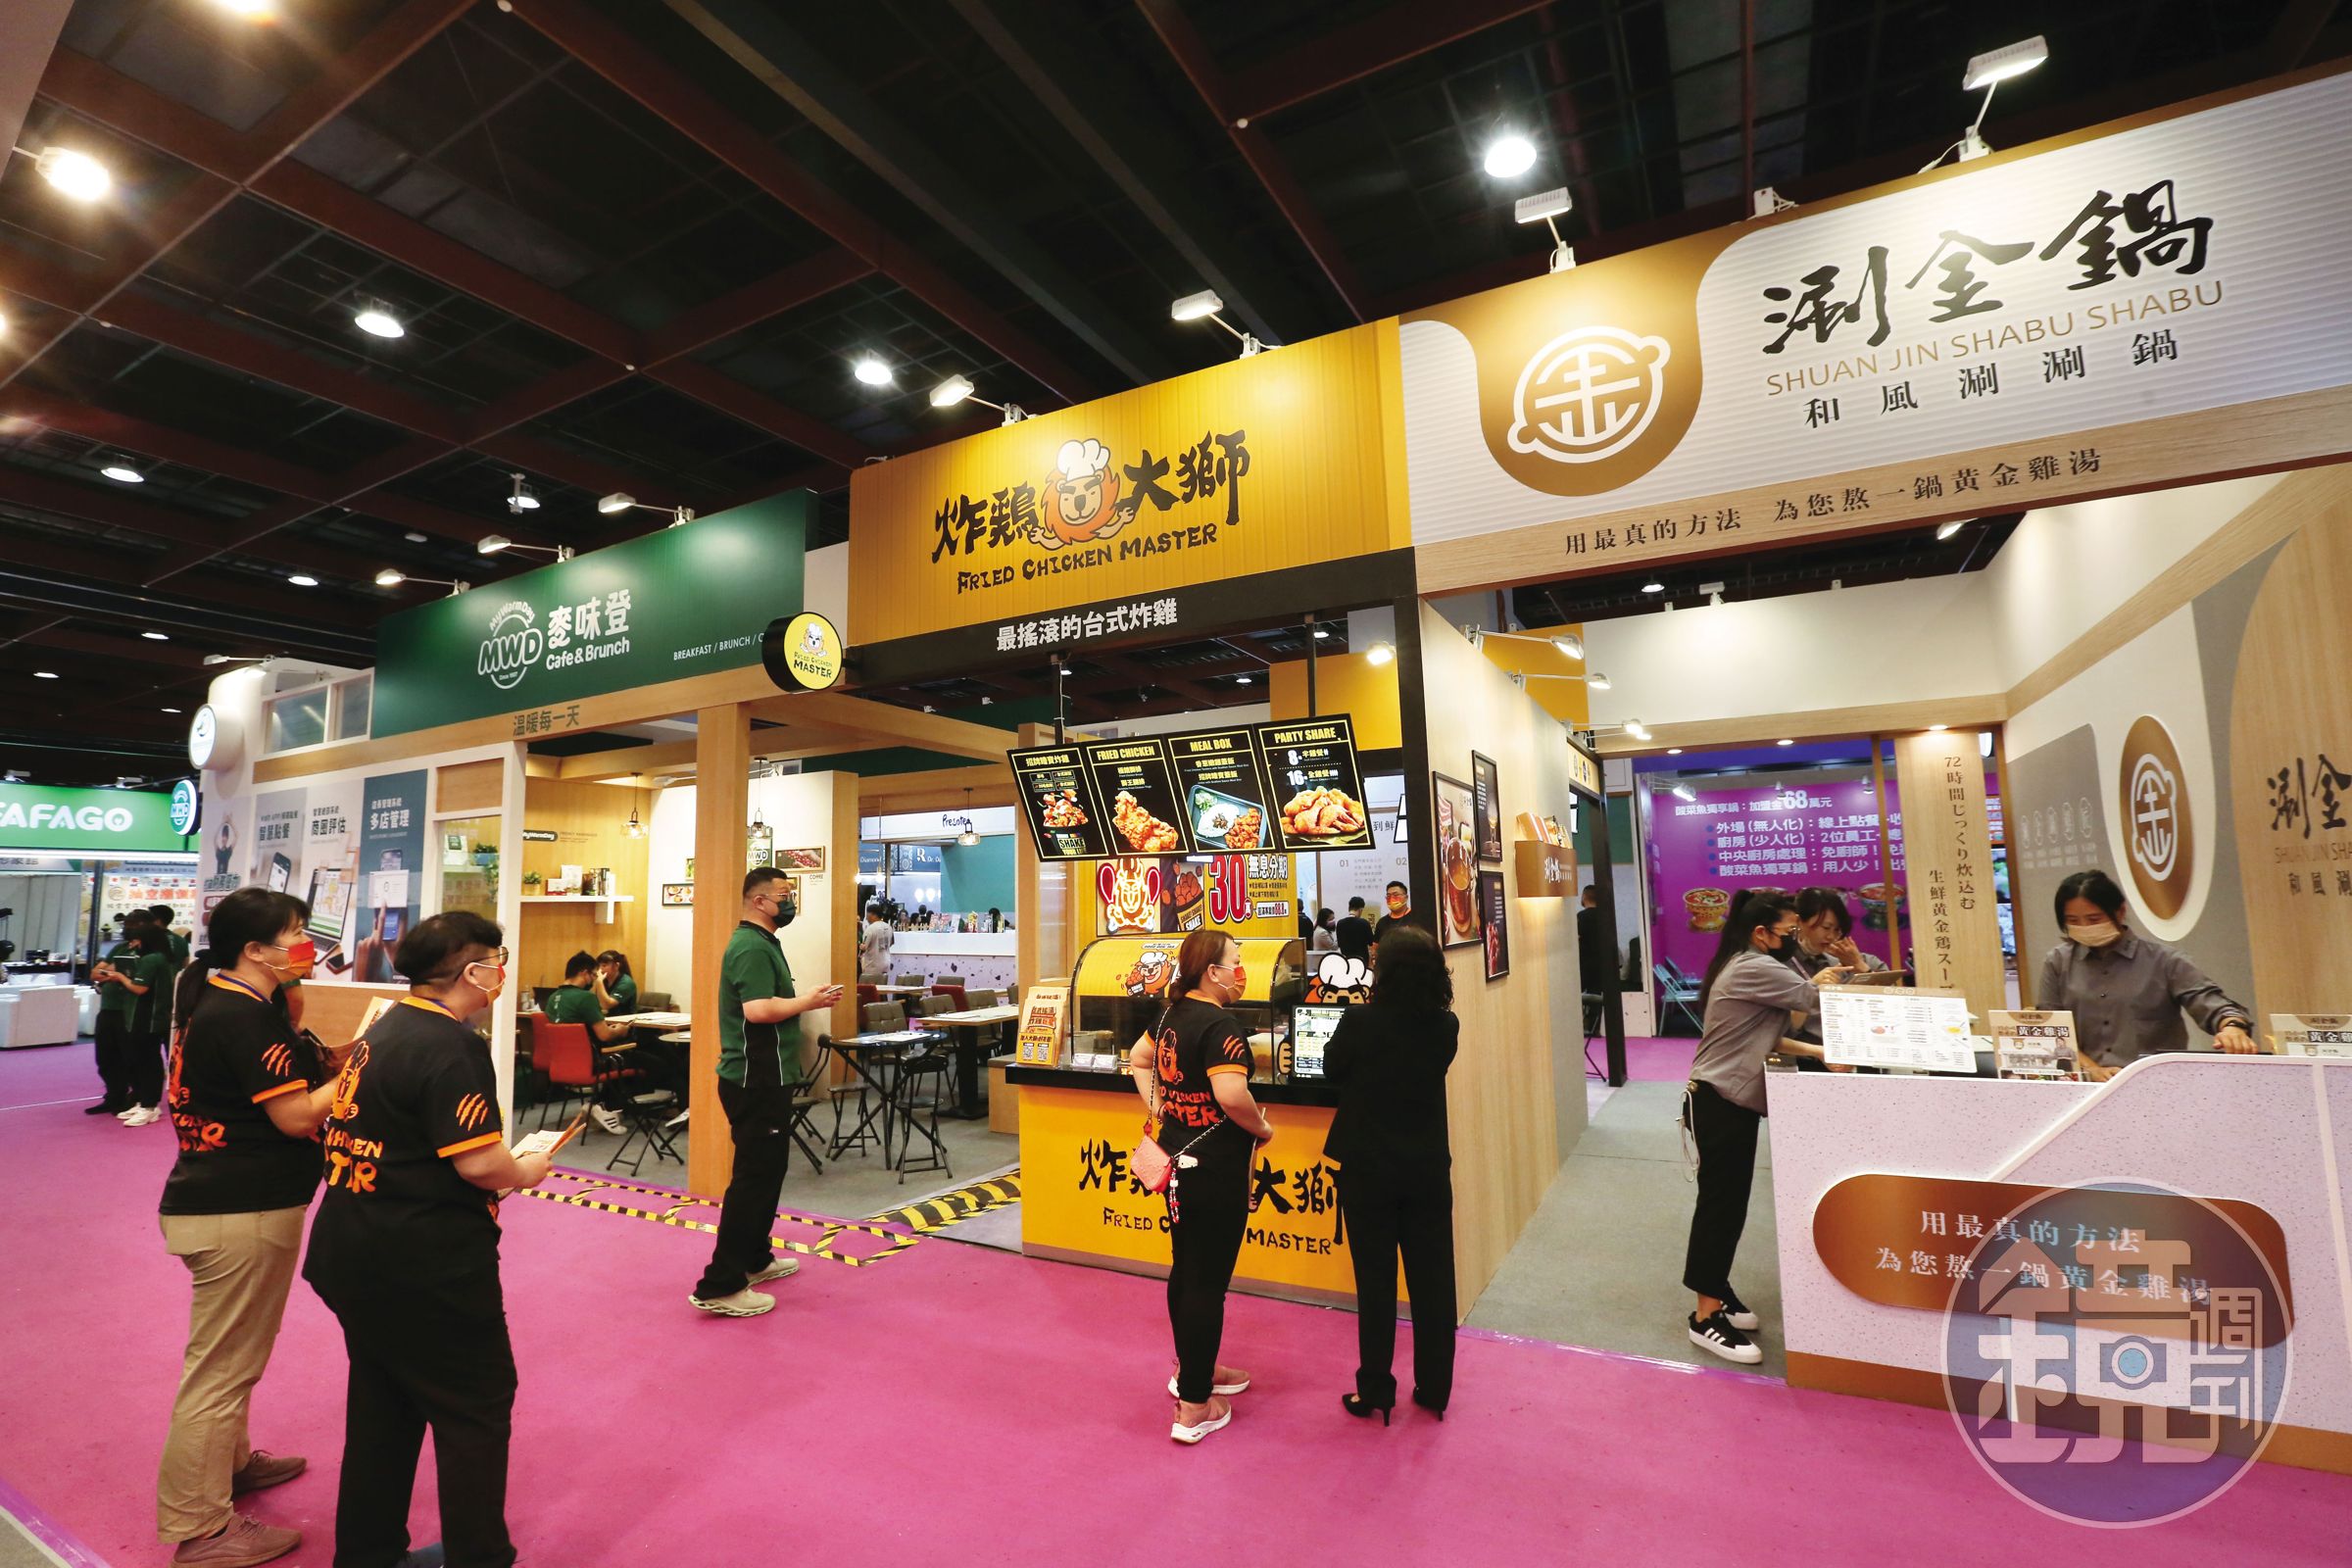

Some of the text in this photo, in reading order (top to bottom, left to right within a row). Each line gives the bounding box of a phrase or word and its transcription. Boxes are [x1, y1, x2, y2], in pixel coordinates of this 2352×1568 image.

[1763, 180, 2214, 354] 涮金鍋
[1767, 279, 2224, 396] SHUAN JIN SHABU SHABU
[1804, 329, 2178, 428] 和風涮涮鍋
[1115, 429, 1250, 525] 大獅
[1565, 507, 1741, 557] 用最真的方法
[957, 522, 1218, 595] FRIED CHICKEN MASTER
[547, 588, 632, 650] 麥味登
[997, 598, 1178, 652] 最搖滾的台式炸雞
[477, 627, 544, 676] MWD
[673, 644, 712, 661] BREAKFAST
[719, 636, 751, 651] BRUNCH
[794, 659, 832, 678] MASTER
[1096, 745, 1155, 760] FRIED CHICKEN
[1190, 738, 1233, 753] MEAL BOX
[1274, 727, 1337, 744] PARTY SHARE
[369, 809, 410, 830] 多店管理
[1059, 838, 1086, 849] SHAKE
[1396, 857, 1407, 865] 02
[1248, 854, 1288, 879] 無息分期
[1339, 858, 1349, 867] 01
[1102, 1206, 1153, 1231] FRIED
[1247, 1227, 1332, 1255] MASTER
